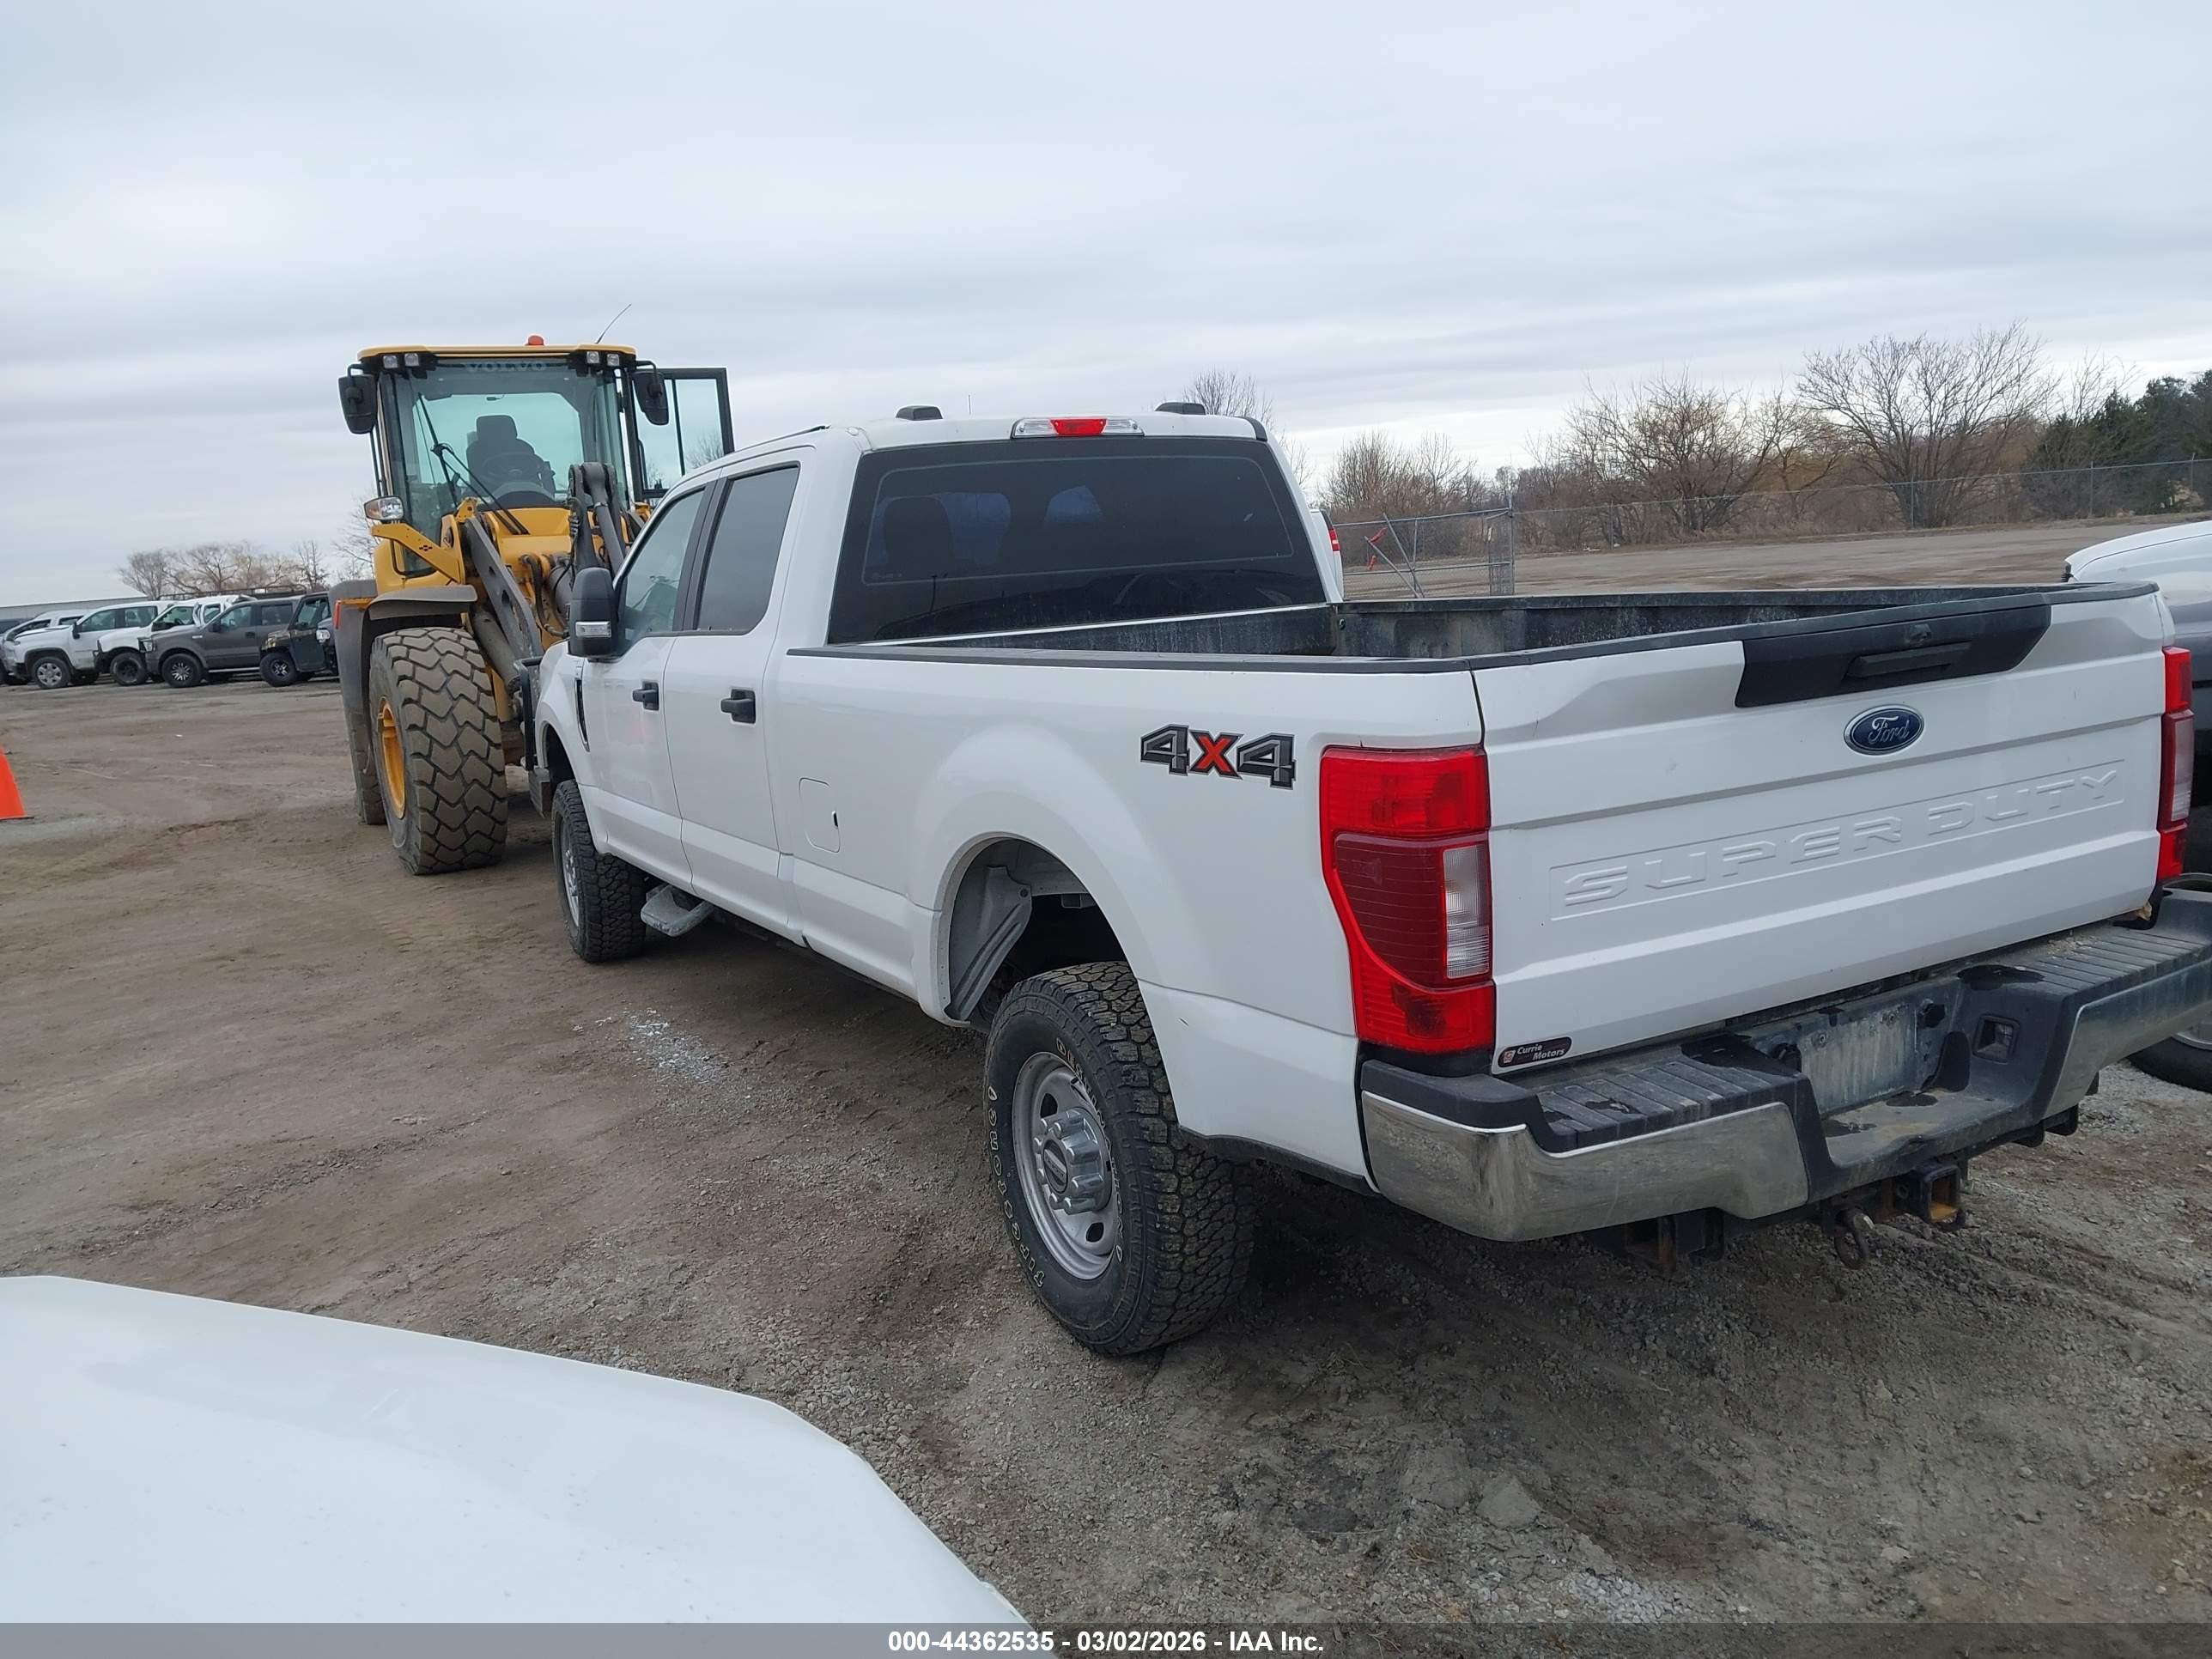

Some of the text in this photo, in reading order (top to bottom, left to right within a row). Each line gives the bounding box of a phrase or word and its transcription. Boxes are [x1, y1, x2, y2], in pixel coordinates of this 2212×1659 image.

[465, 361, 549, 373] VOLVO
[1868, 715, 1911, 744] Ford
[1564, 769, 2118, 907] SUPER DUTY
[1516, 1044, 1543, 1055] Currie
[1532, 1048, 1565, 1060] Motors
